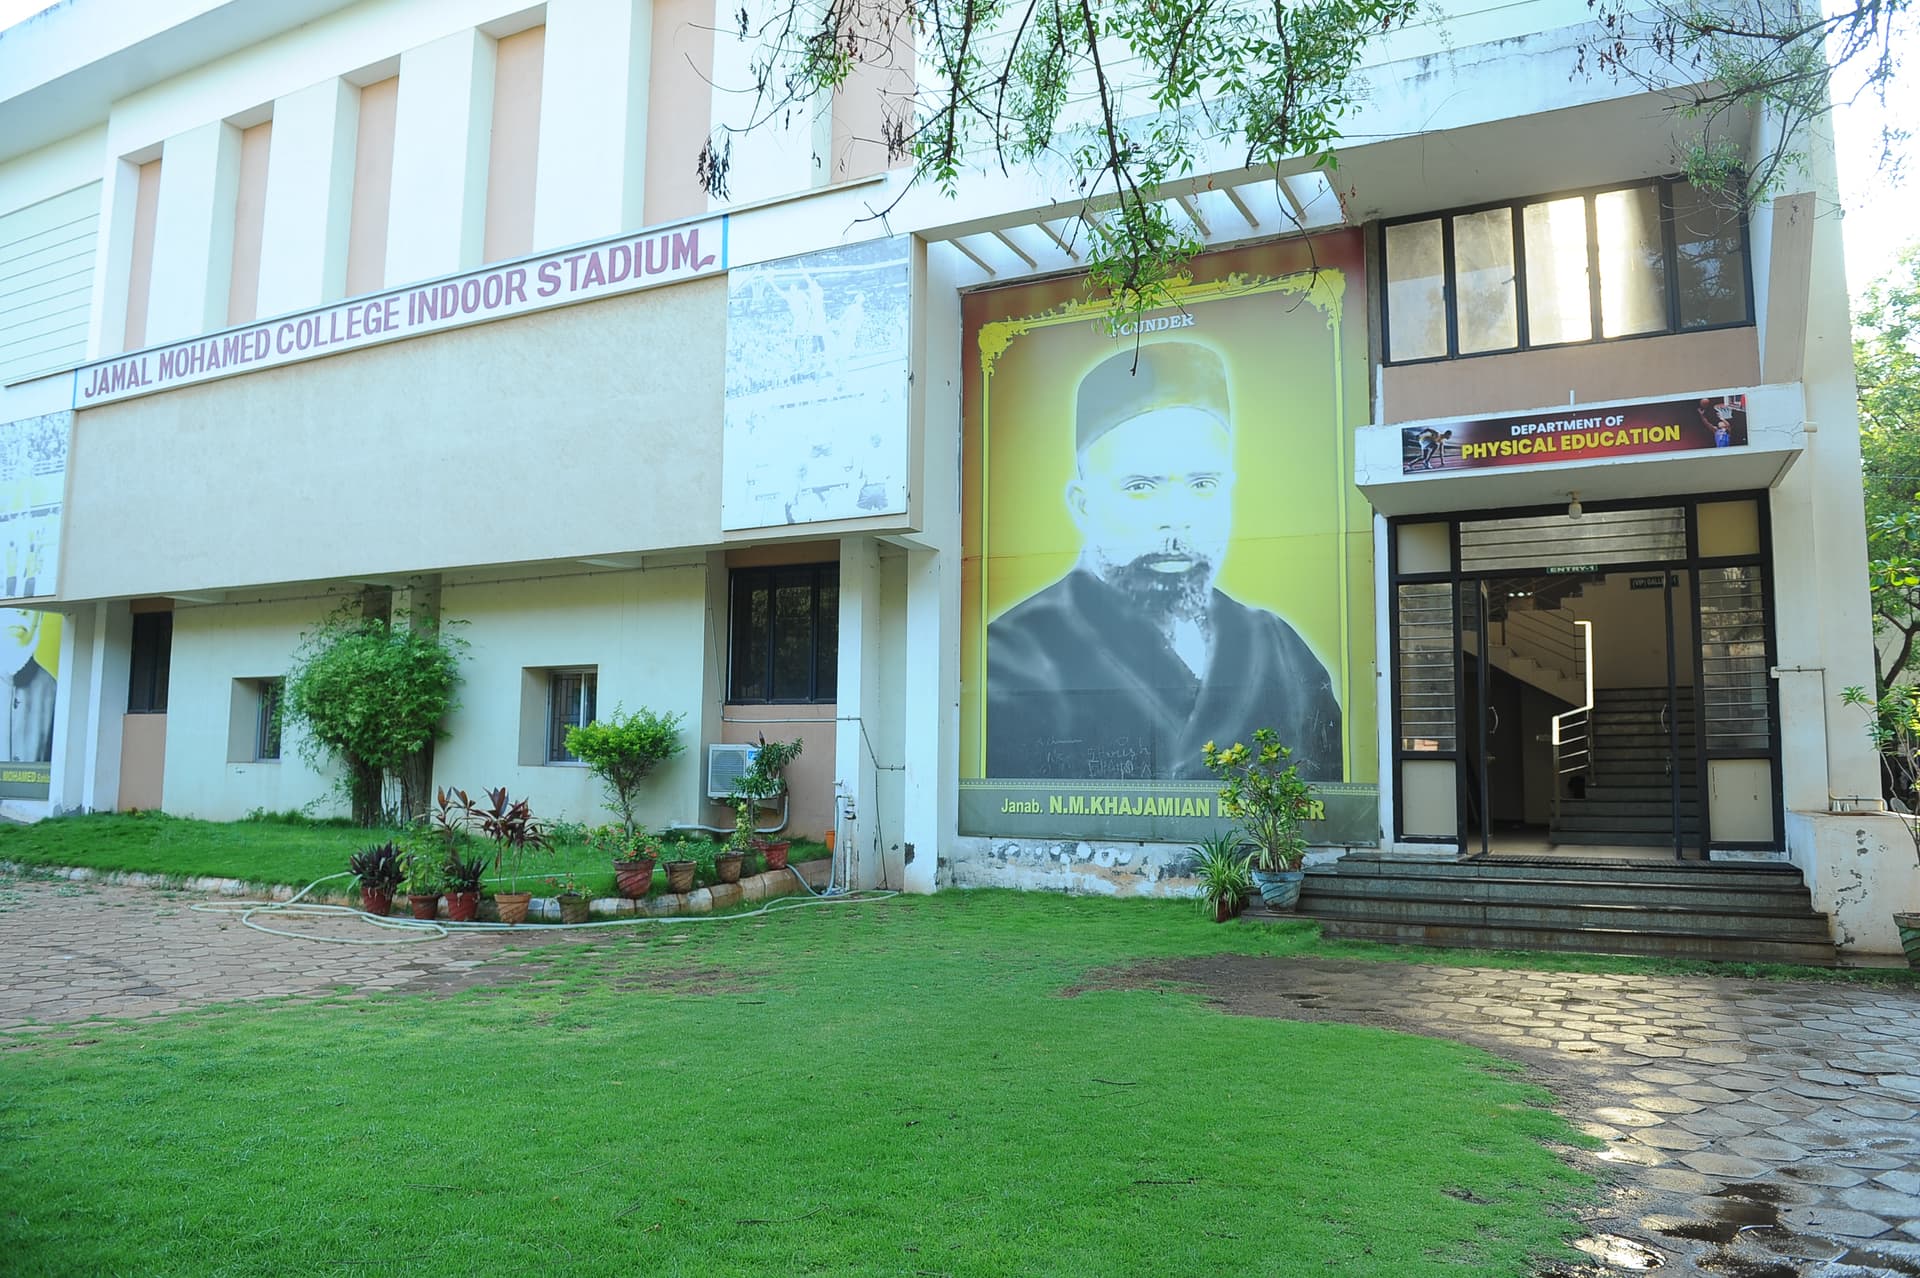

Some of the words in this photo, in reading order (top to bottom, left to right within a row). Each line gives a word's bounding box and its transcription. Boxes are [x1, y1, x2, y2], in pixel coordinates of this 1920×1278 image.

[84, 353, 152, 399] JAMAL
[159, 329, 271, 382] MOHAMED
[276, 296, 400, 355] COLLEGE
[408, 268, 527, 327] INDOOR
[537, 228, 716, 298] STADIUM
[1511, 416, 1602, 436] DEPARTMENT
[1605, 414, 1625, 427] OF
[1461, 436, 1557, 460] PHYSICAL
[1561, 424, 1681, 451] EDUCATION
[1001, 798, 1044, 814] Janab.
[1049, 795, 1210, 817] N.M.KHAJAMIAN
